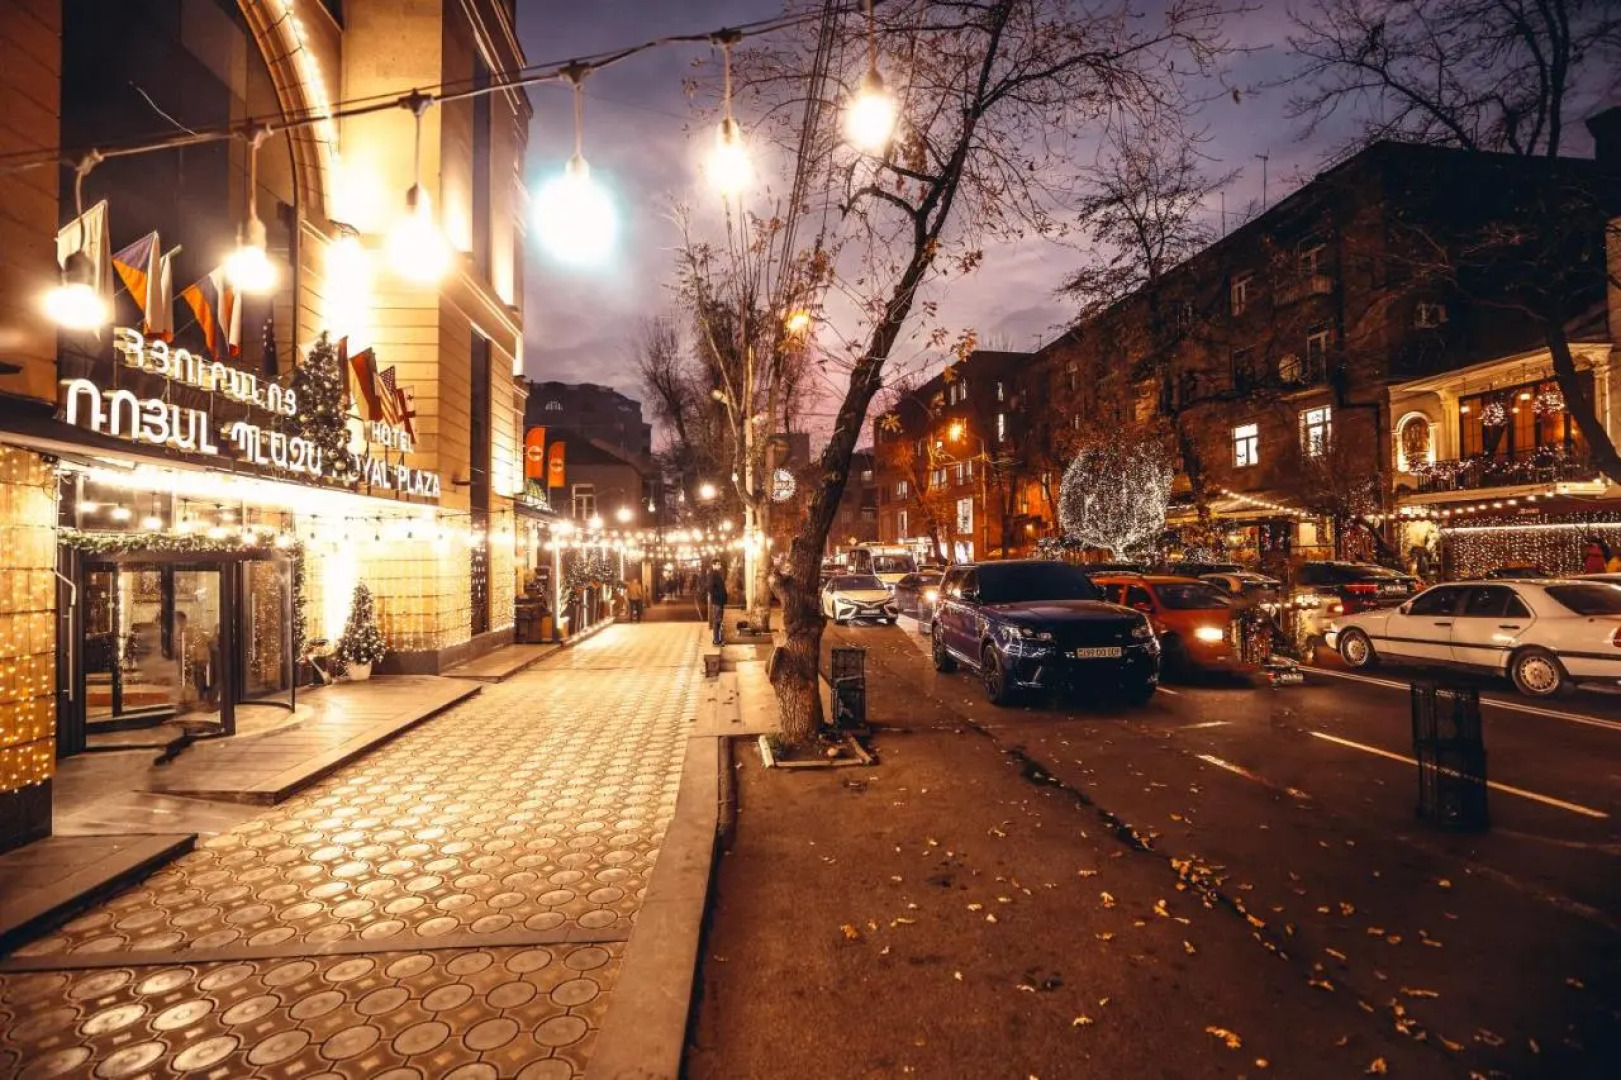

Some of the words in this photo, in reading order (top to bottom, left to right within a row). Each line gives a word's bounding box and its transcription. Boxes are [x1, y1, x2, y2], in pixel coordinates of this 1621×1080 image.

[62, 378, 219, 456] ՌՈՅԱԼ
[221, 421, 323, 477] ՊԼԱԶԱ
[370, 419, 415, 454] HOTEL
[395, 464, 442, 498] PLAZA
